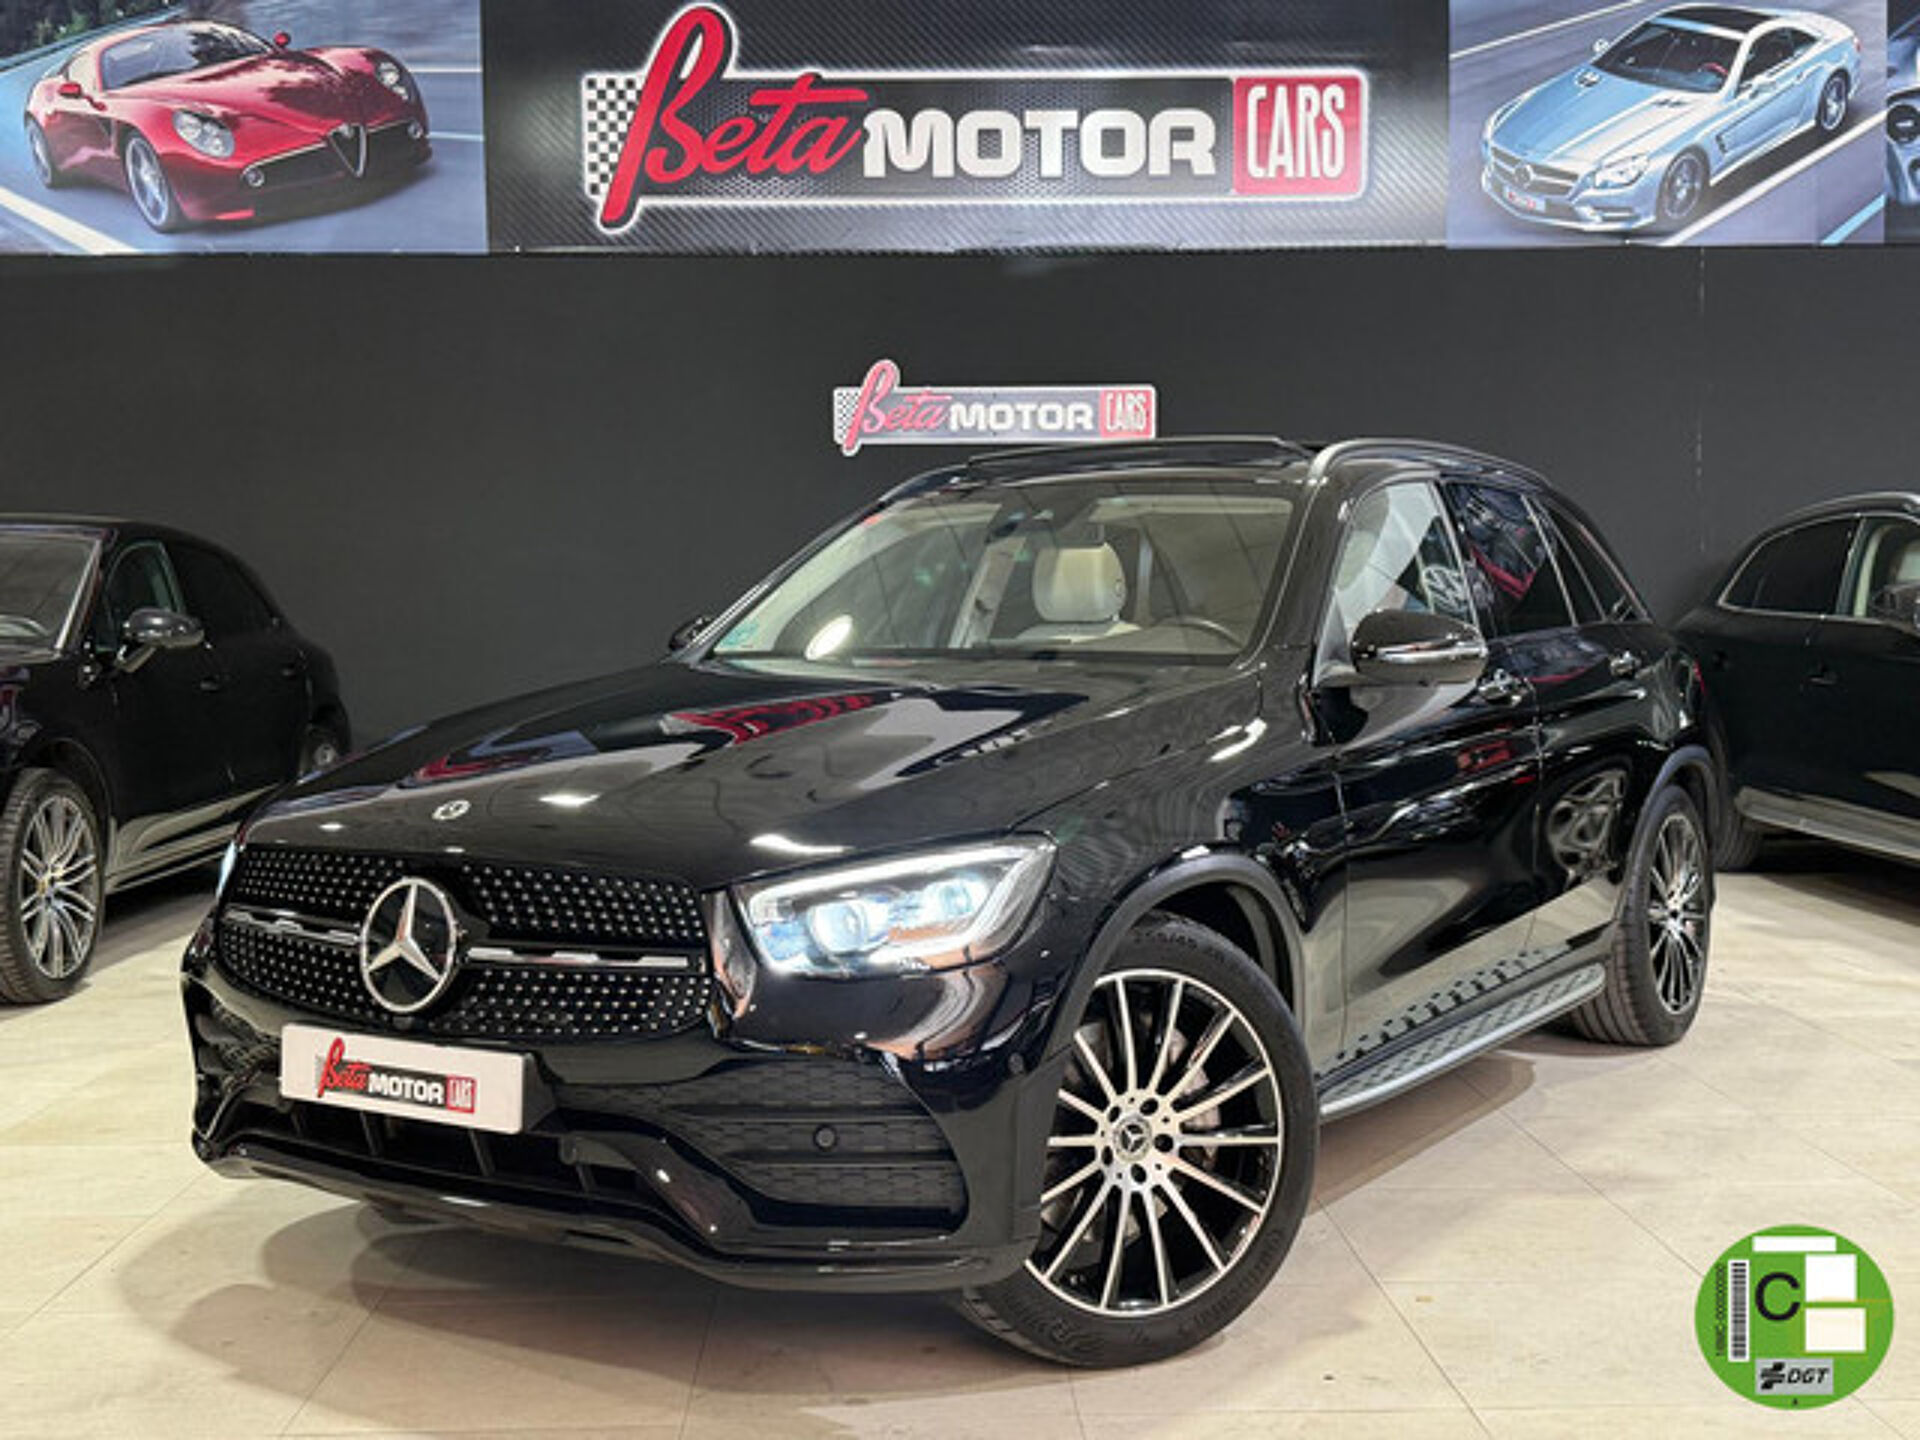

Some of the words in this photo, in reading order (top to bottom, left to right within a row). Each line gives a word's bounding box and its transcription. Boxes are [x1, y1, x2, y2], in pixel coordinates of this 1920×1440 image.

[863, 108, 1216, 178] MOTOR
[1244, 83, 1345, 181] CARS
[950, 402, 1094, 432] MOTOR
[1105, 391, 1147, 432] CARS
[368, 1073, 445, 1105] MOTOR
